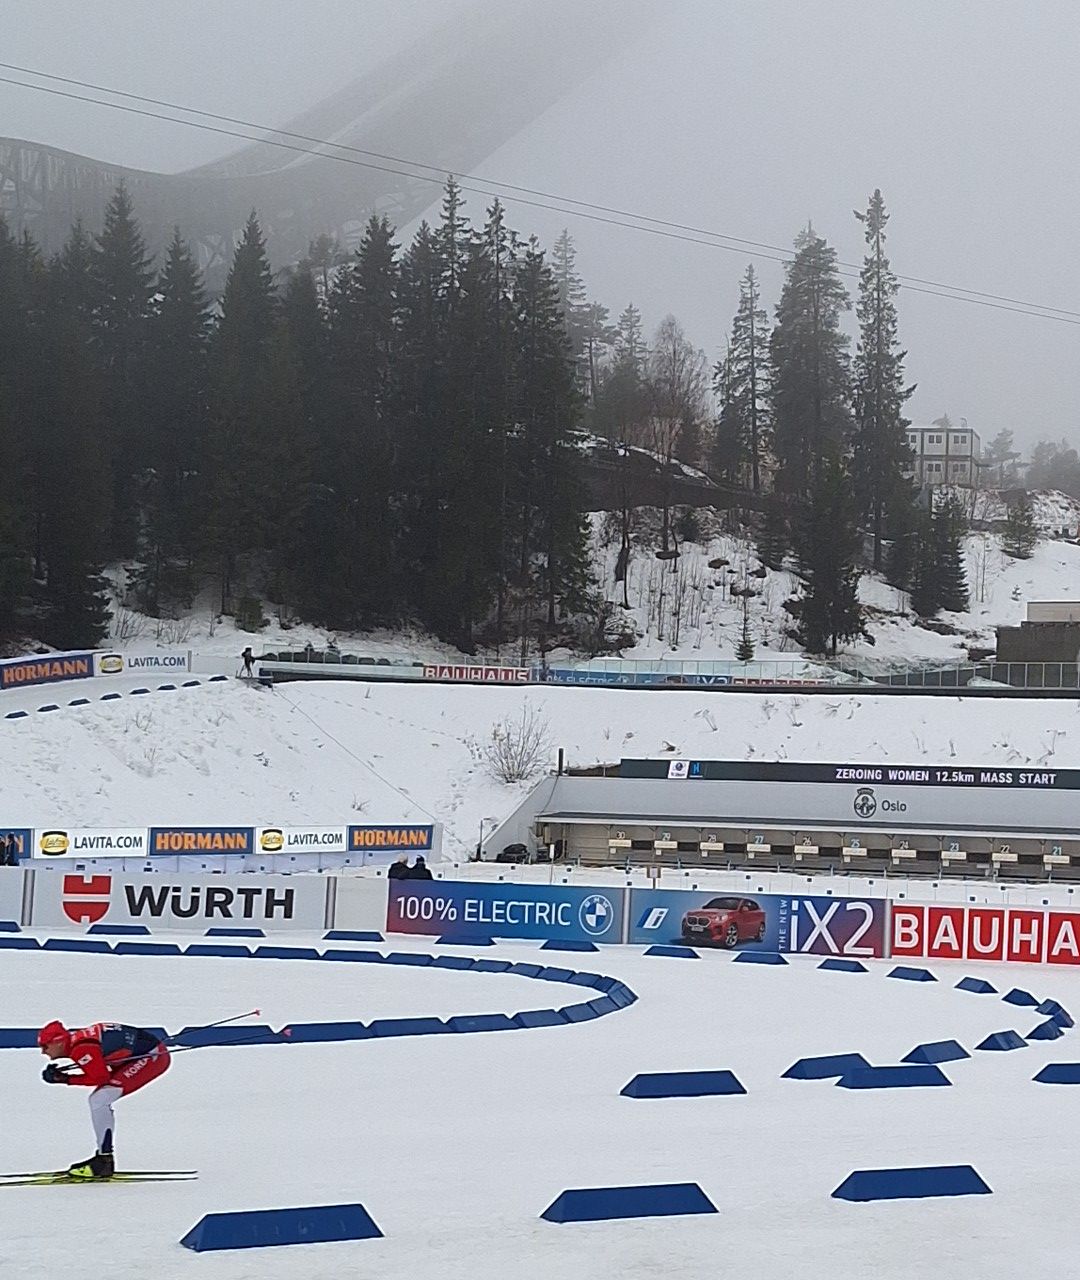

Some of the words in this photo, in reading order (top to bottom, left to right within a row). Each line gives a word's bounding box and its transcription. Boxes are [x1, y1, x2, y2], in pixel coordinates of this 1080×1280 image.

[128, 655, 186, 668] LAVITA.COM
[835, 768, 882, 780] ZEROING
[888, 770, 930, 781] WOMEN
[936, 771, 975, 783] 12.5km
[980, 772, 1013, 783] MASS
[1018, 773, 1057, 784] START
[881, 799, 907, 812] Oslo
[74, 836, 143, 850] LAVITA.COM
[287, 833, 343, 845] LAVITA.COM
[850, 839, 860, 848] 25
[900, 840, 909, 849] 24
[950, 842, 959, 851] 23
[1000, 845, 1010, 853] 22
[1052, 846, 1062, 855] 21
[124, 885, 295, 919] WÜRTH
[397, 896, 457, 921] 100%
[464, 899, 572, 926] ELECTRIC
[780, 899, 788, 924] NEW
[789, 900, 875, 956] iX2
[779, 927, 787, 950] THE
